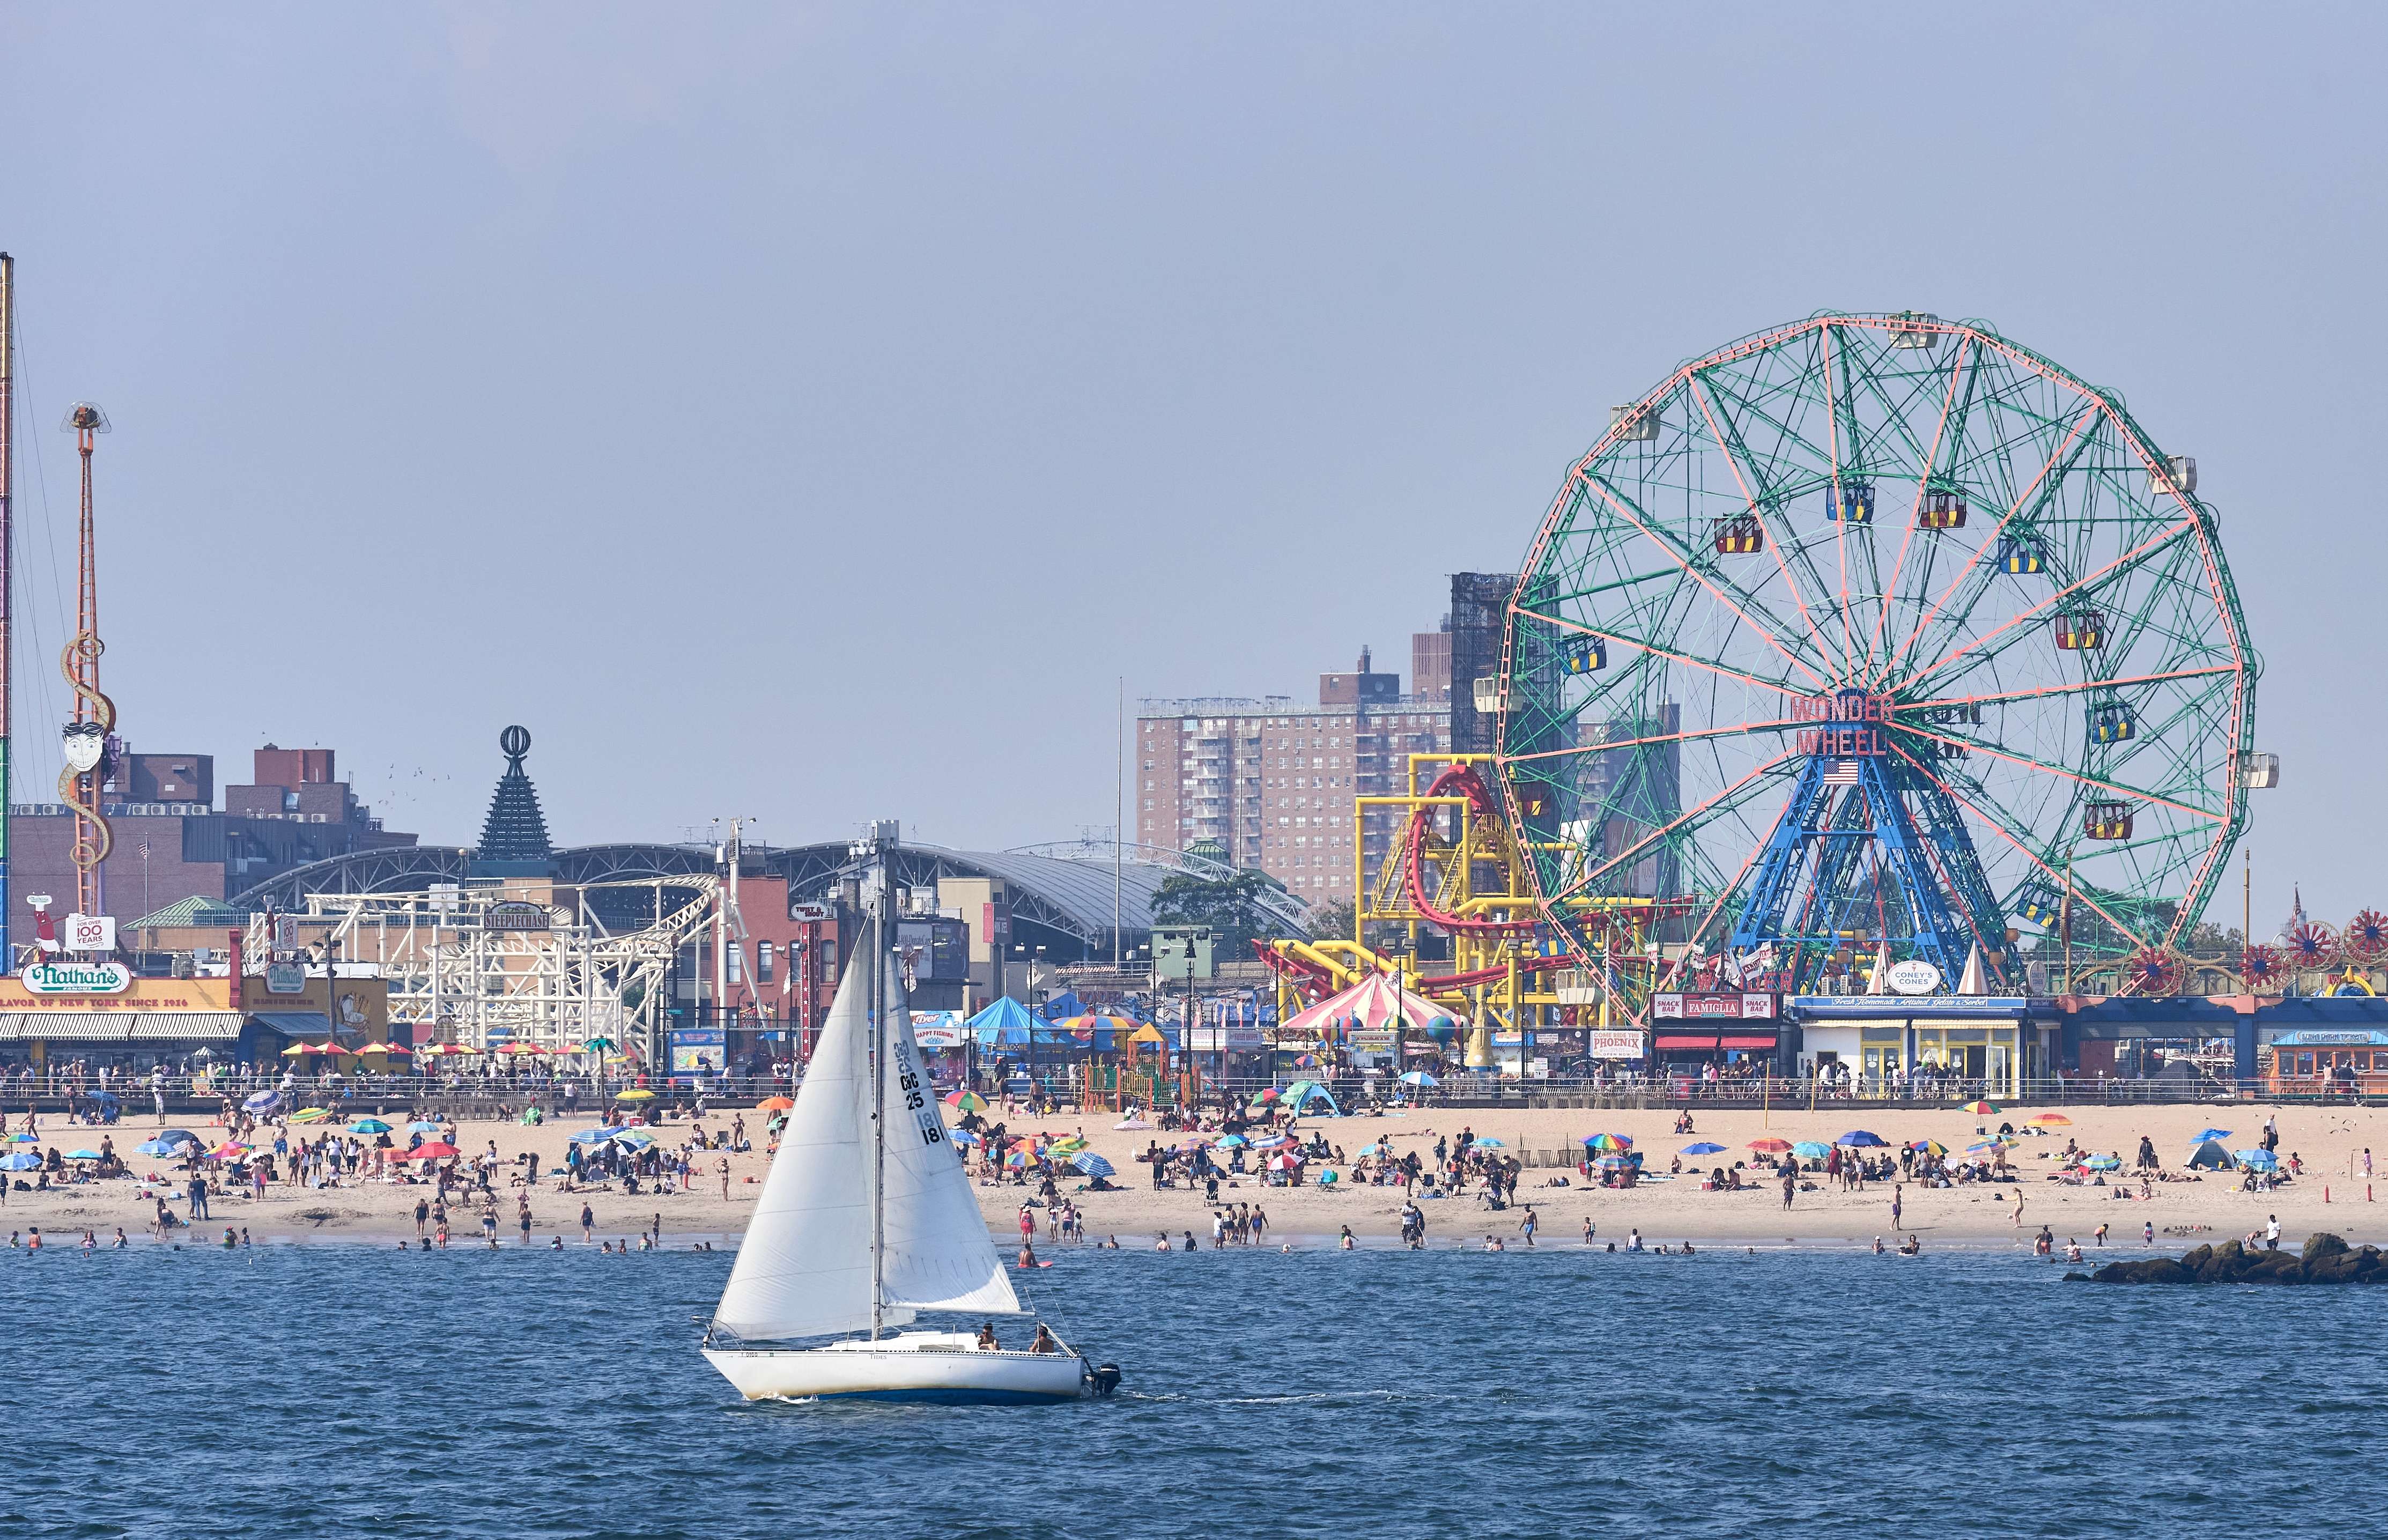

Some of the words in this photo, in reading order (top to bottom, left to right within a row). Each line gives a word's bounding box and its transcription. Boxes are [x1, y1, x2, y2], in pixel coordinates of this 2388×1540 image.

[1791, 695, 1895, 721] WONDER
[1797, 730, 1887, 755] WHEEL
[486, 914, 547, 927] STEEPLECHASE
[77, 925, 102, 937] 100
[77, 935, 102, 944] YEARS
[32, 966, 121, 984] Nathan's
[1855, 998, 1896, 1006] Homemade
[1689, 1004, 1736, 1013] FAMIGLIA
[915, 1013, 940, 1024] flyer
[1594, 1038, 1639, 1050] PHOENIX
[906, 1092, 924, 1110] 25
[922, 1125, 945, 1145] 181
